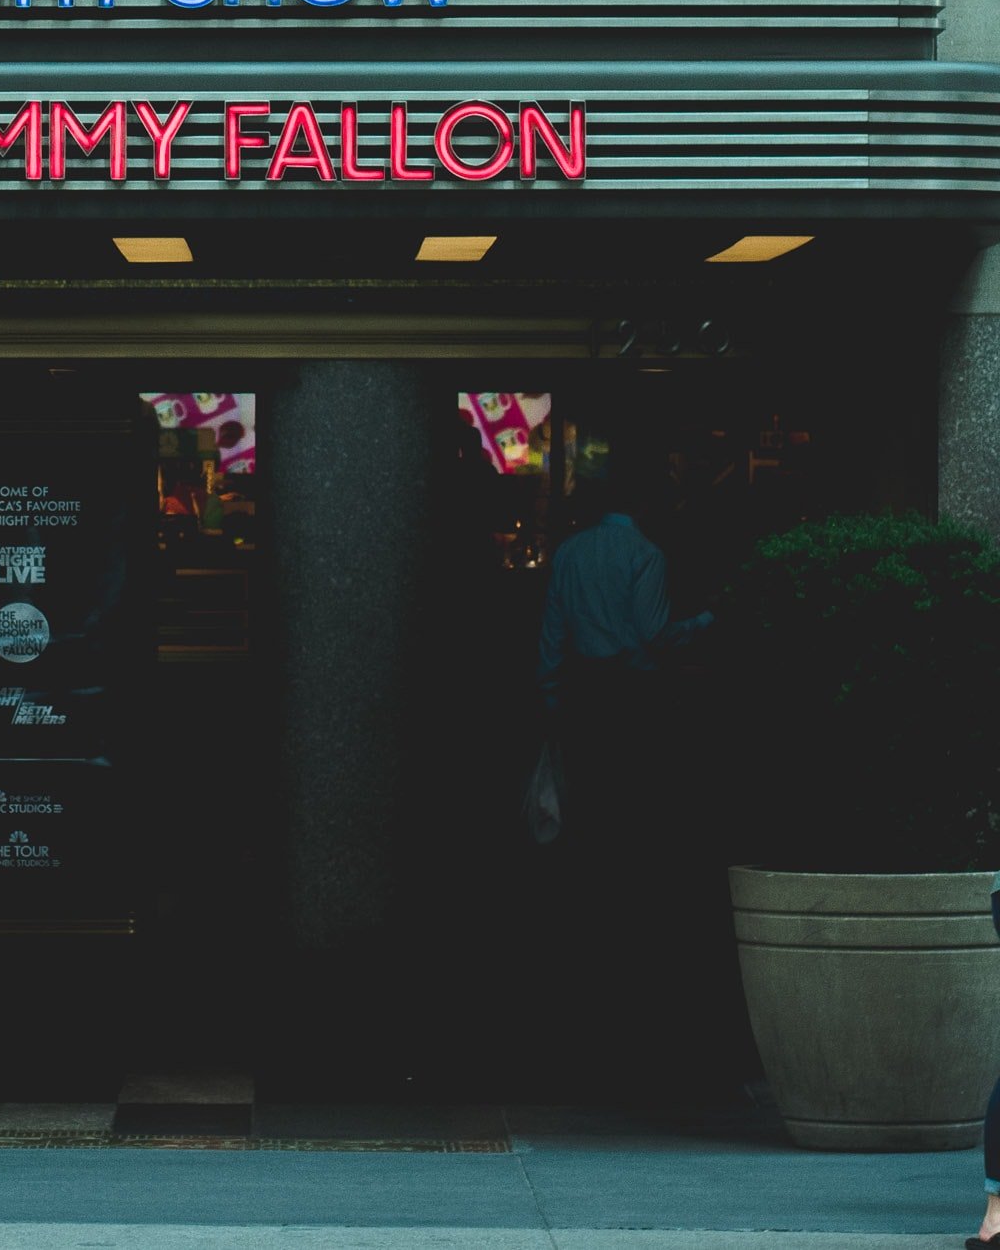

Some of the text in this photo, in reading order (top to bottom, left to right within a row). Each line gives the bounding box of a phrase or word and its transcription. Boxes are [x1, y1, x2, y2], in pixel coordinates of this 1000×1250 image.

[224, 99, 586, 181] FALLON
[32, 486, 49, 497] OF
[26, 501, 81, 512] FAVORITE
[33, 515, 78, 526] SHOWS
[13, 637, 43, 646] JIMMY
[3, 645, 41, 656] FALLON
[18, 705, 53, 716] SETH
[14, 715, 67, 725] MEYERS
[9, 795, 21, 803] THE
[9, 803, 53, 814] STUDIOS
[14, 845, 49, 858] TOUR
[16, 859, 50, 868] STUDIOS
